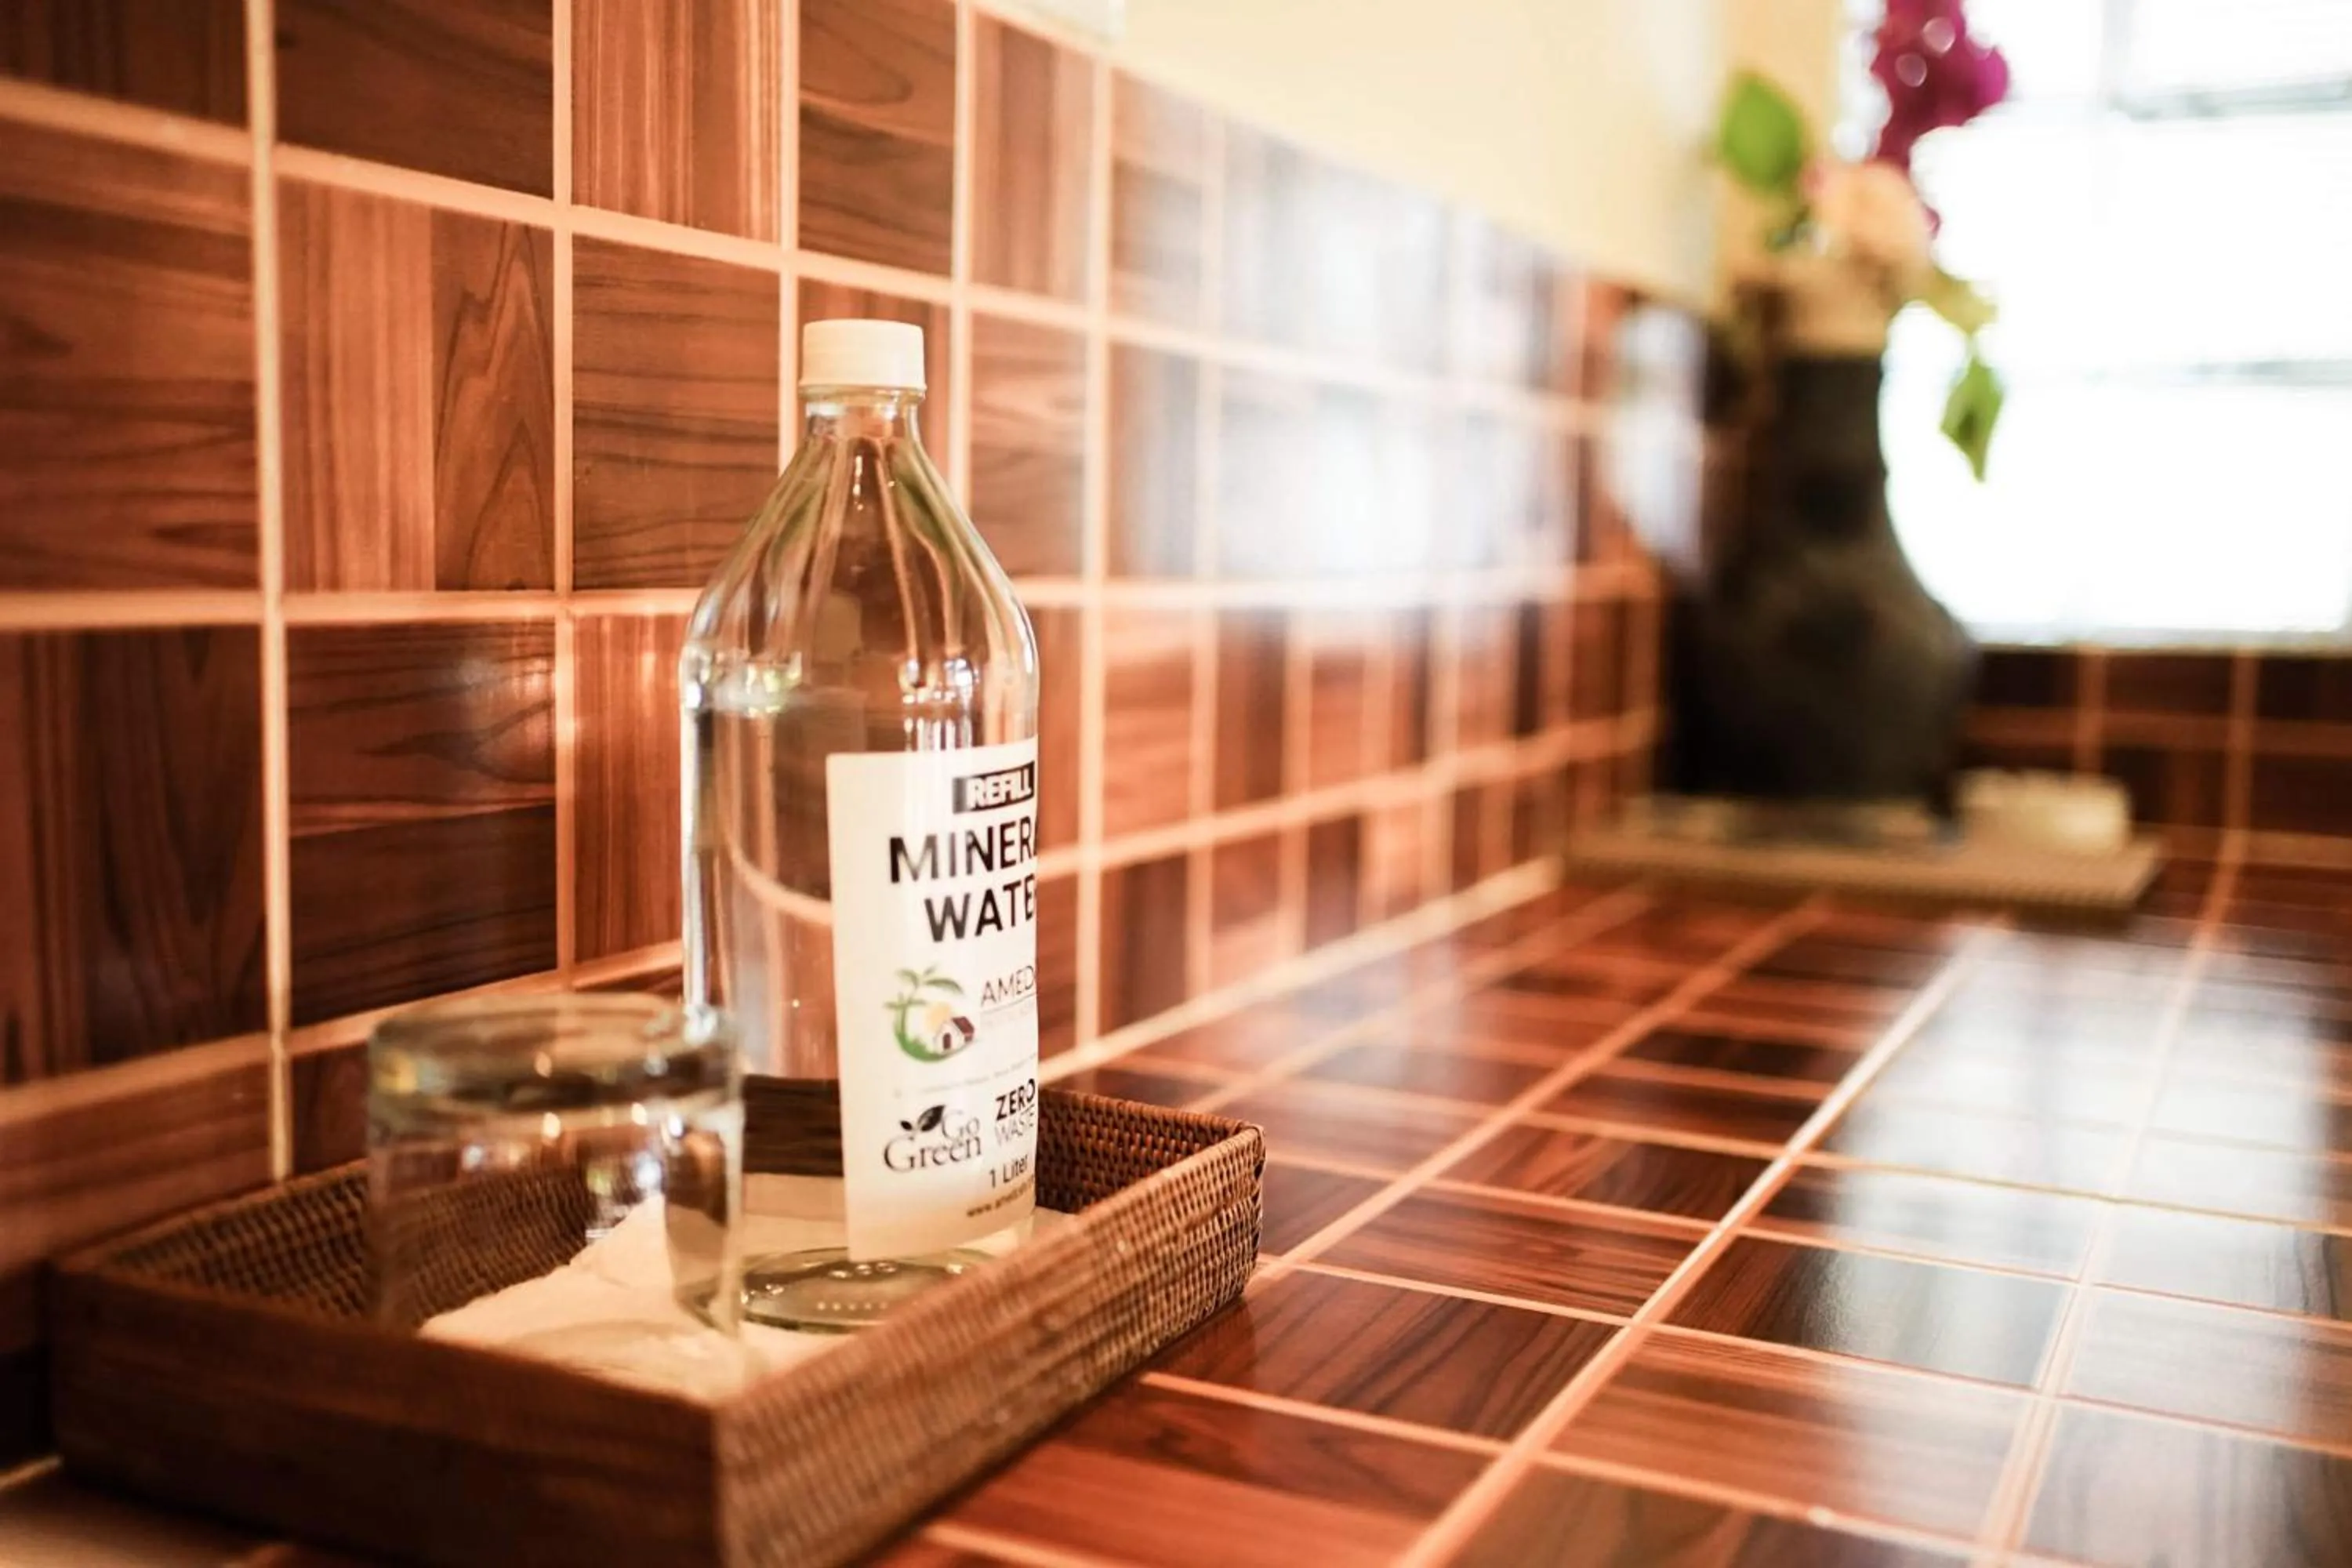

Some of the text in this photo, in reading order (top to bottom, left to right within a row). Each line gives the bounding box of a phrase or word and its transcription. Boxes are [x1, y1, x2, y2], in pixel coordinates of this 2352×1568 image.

[966, 768, 1032, 809] REFILL
[889, 815, 1036, 884] MINER
[996, 1078, 1036, 1121] ZERO
[941, 1109, 981, 1142] Go
[884, 1135, 982, 1173] Green
[989, 1154, 1029, 1189] 1 Liter
